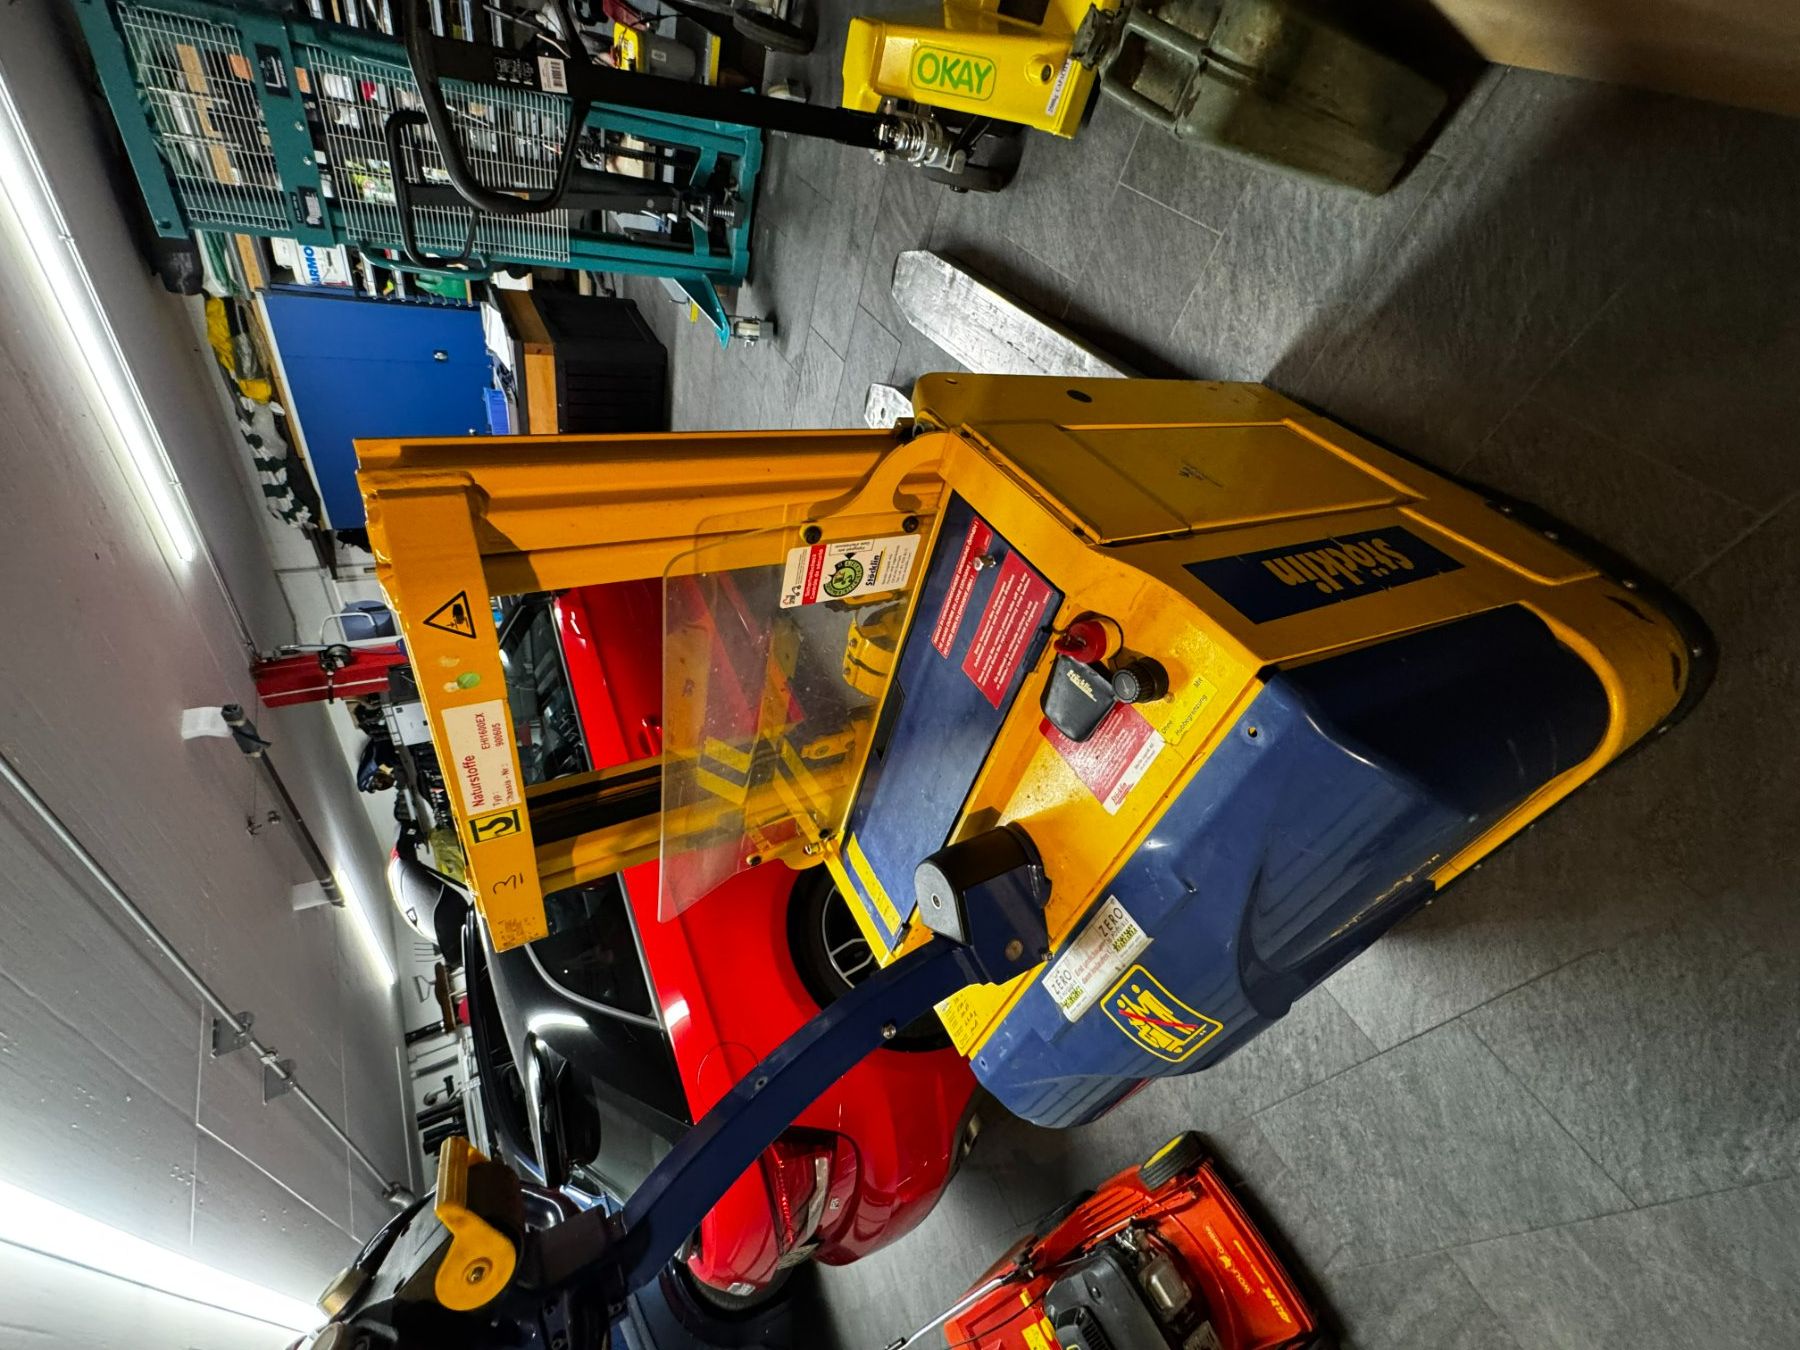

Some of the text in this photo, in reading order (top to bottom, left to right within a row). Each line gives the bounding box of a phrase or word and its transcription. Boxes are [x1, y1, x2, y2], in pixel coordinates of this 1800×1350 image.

[917, 52, 994, 96] OKAY
[866, 555, 879, 586] Stöcklin
[1263, 537, 1415, 594] Stöcklin
[1175, 693, 1208, 736] Hubbegrenzung
[462, 755, 484, 808] Naturstoffe
[1098, 907, 1123, 937] ZERO
[1051, 969, 1071, 991] ZERO
